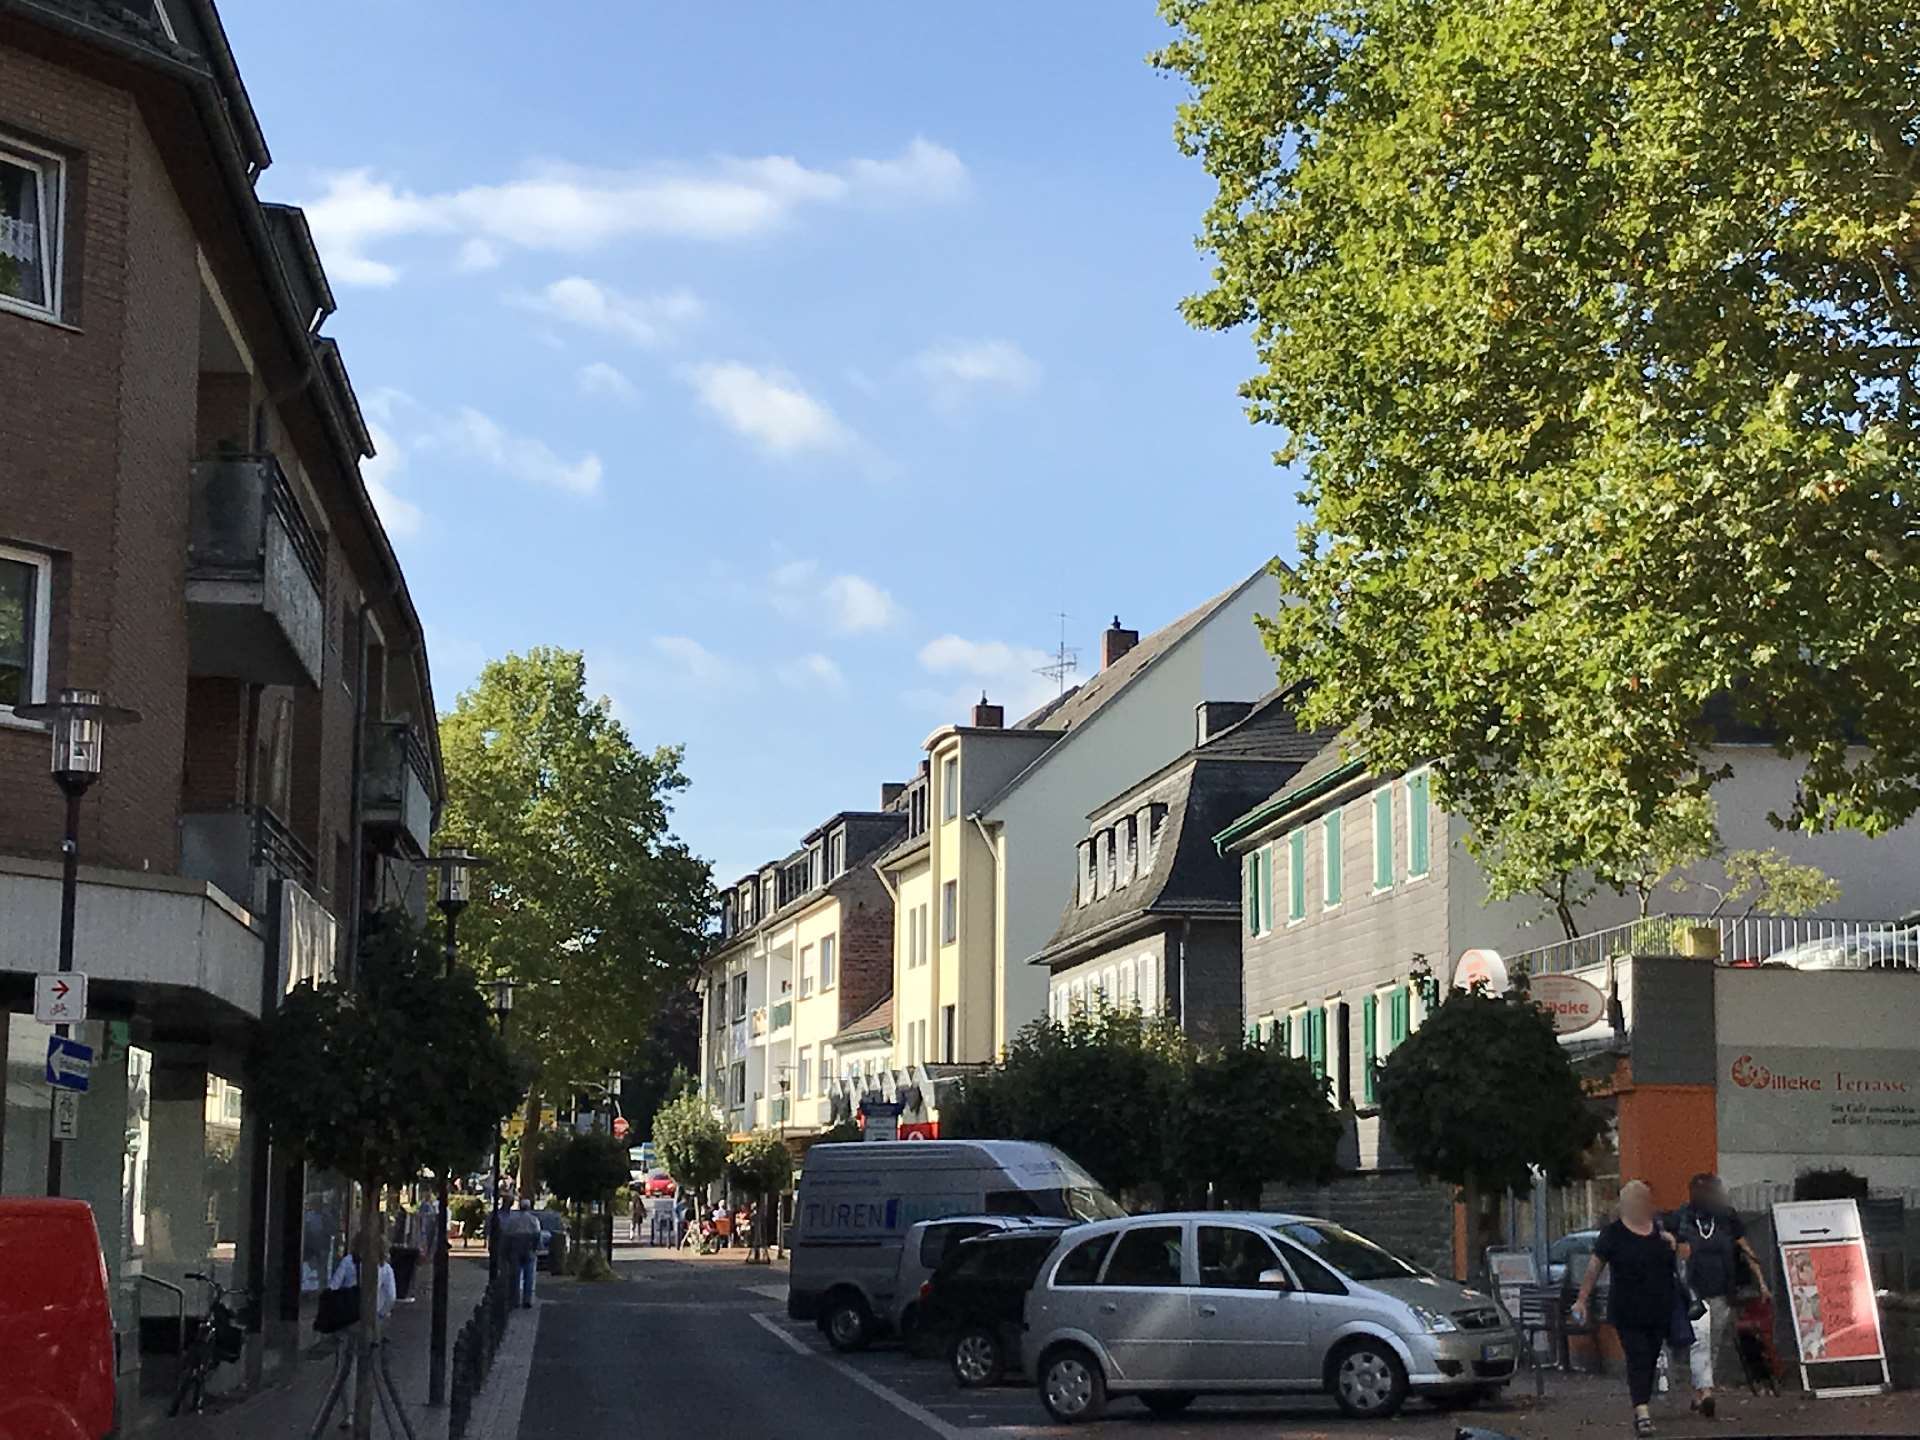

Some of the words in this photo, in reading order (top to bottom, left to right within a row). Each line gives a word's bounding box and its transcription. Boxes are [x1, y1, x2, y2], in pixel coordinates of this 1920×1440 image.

[1536, 1000, 1590, 1014] illeke
[1835, 1072, 1907, 1093] Terrasse
[805, 1199, 882, 1228] TÜREN
